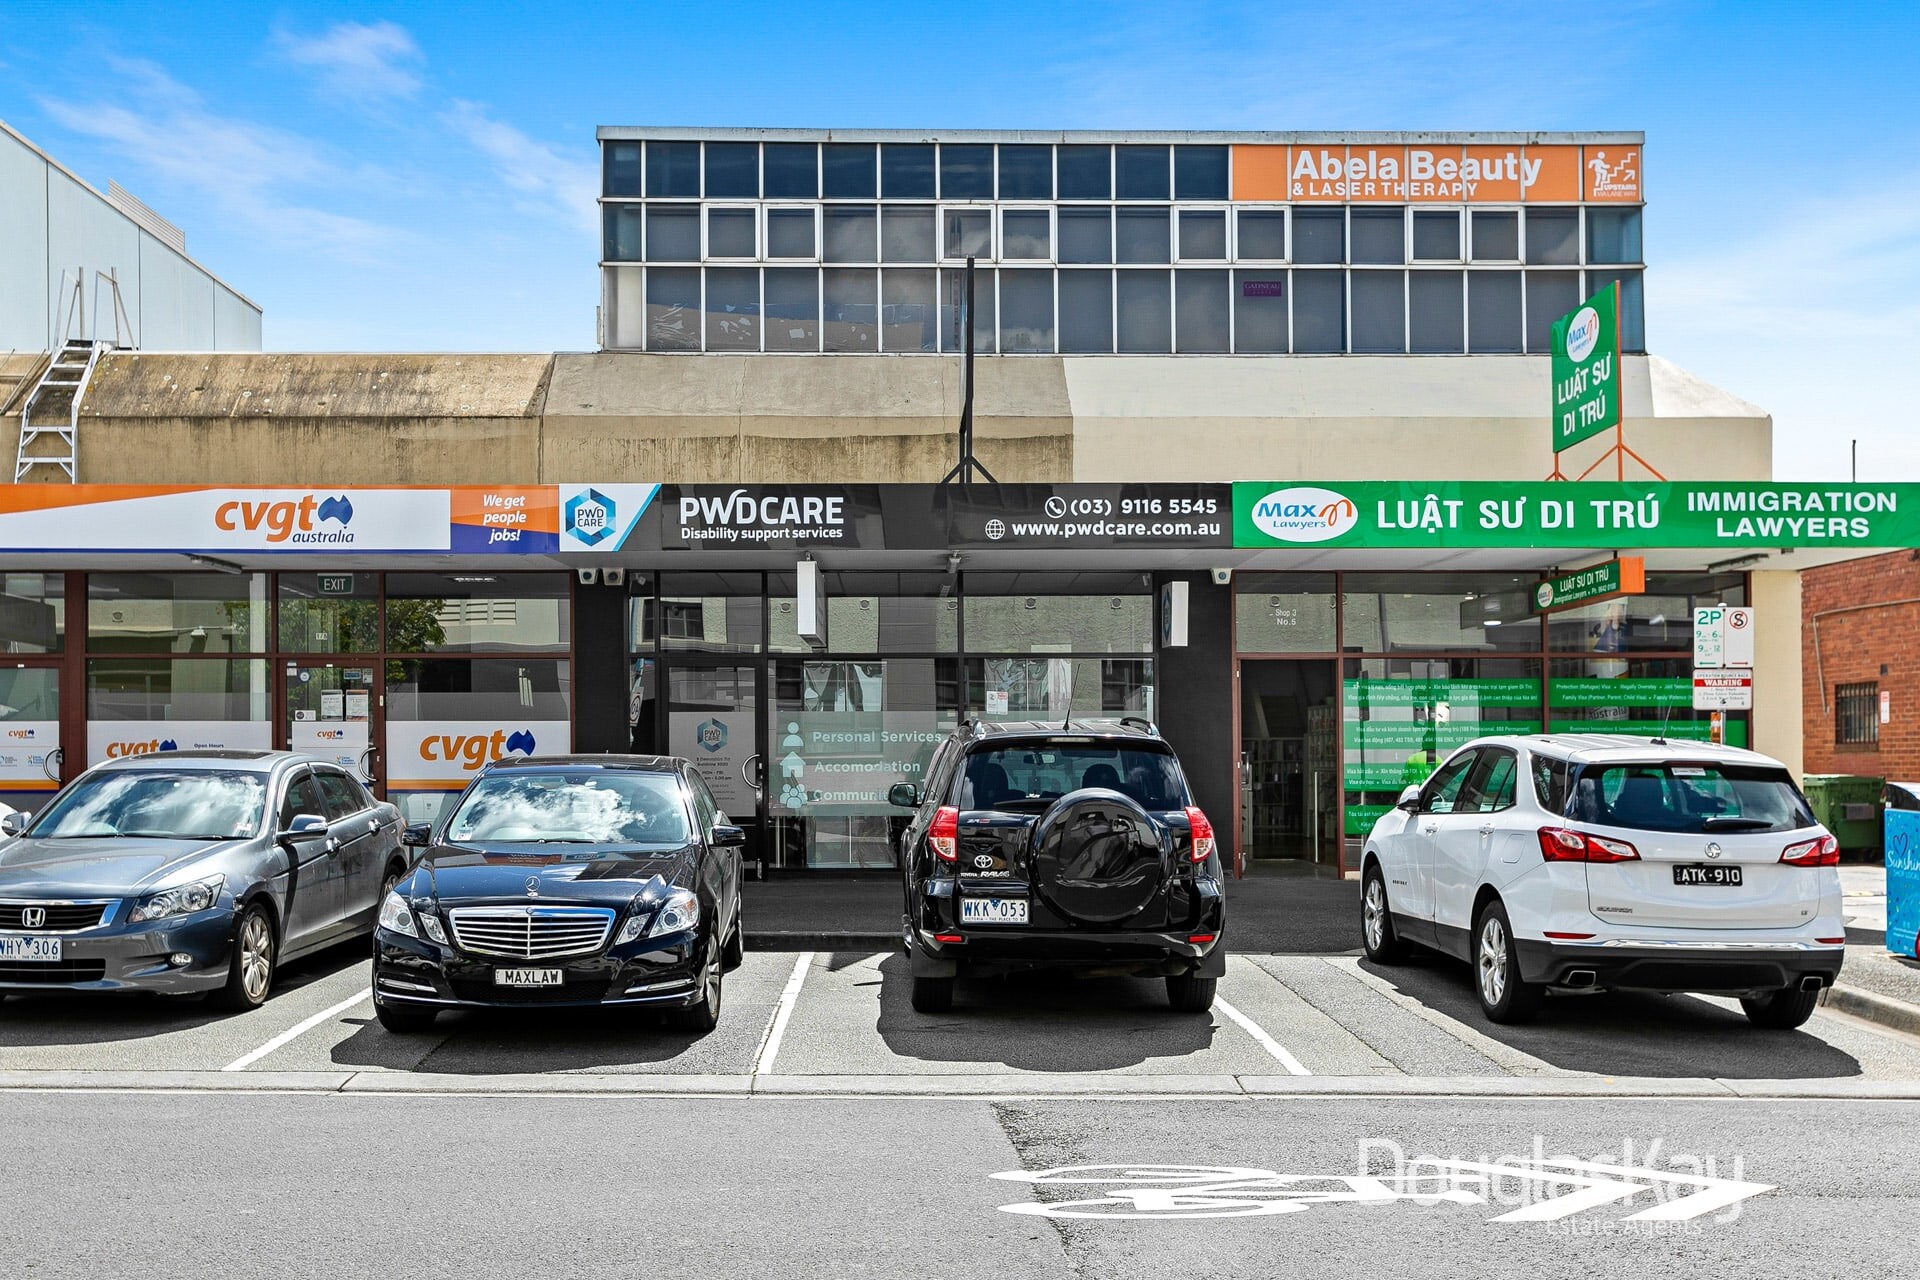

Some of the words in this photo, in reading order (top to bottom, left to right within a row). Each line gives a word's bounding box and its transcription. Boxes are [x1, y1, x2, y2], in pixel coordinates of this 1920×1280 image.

[1292, 149, 1398, 180] Abela
[1410, 149, 1542, 186] Beauty
[1292, 182, 1304, 196] &
[1309, 182, 1376, 196] LASER
[1381, 182, 1478, 196] THERAPY
[1568, 322, 1587, 346] Max
[1558, 368, 1589, 405] LUẬT
[1592, 352, 1611, 386] SƯ
[1563, 411, 1576, 436] DI
[1579, 389, 1606, 428] TRÚ
[483, 494, 502, 507] We
[503, 495, 525, 510] get
[1070, 499, 1112, 516] (03)
[1121, 499, 1162, 514] 9116
[1169, 499, 1217, 514] 5545
[1688, 491, 1898, 513] IMMIGRATION
[577, 506, 604, 518] PWD
[1257, 502, 1317, 518] Max
[1377, 493, 1464, 534] LUẬT
[1479, 496, 1525, 529] SƯ
[1540, 500, 1575, 529] DI
[1590, 492, 1660, 529] TRÚ
[214, 494, 318, 542] cvgt
[483, 511, 526, 526] people
[577, 518, 604, 527] CARE
[1273, 520, 1326, 530] Lawyers
[489, 528, 521, 543] jobs!
[681, 527, 739, 542] Disability
[741, 528, 790, 542] support
[792, 527, 843, 538] services
[1012, 520, 1221, 538] www.pwdcare.com.au
[1716, 518, 1870, 538] LAWYERS
[292, 529, 354, 543] australia
[323, 578, 346, 591] EXIT
[1587, 571, 1594, 585] DI
[1275, 609, 1291, 617] Shop
[1292, 608, 1297, 617] 3
[1697, 610, 1722, 625] 2P
[1276, 618, 1297, 626] No.5
[1703, 679, 1743, 687] WARNING
[8, 729, 28, 738] cvgt
[317, 729, 337, 740] cvgt
[813, 731, 876, 743] Personal
[881, 731, 942, 743] Services
[419, 729, 507, 770] cvgt
[814, 761, 921, 773] Accomodation
[813, 789, 889, 801] Communit
[1887, 849, 1920, 871] Sunshin
[964, 901, 989, 916] WKK
[1000, 902, 1026, 917] 053
[0, 940, 22, 954] WHY
[33, 940, 58, 955] 306
[505, 970, 559, 983] MAXLAW
